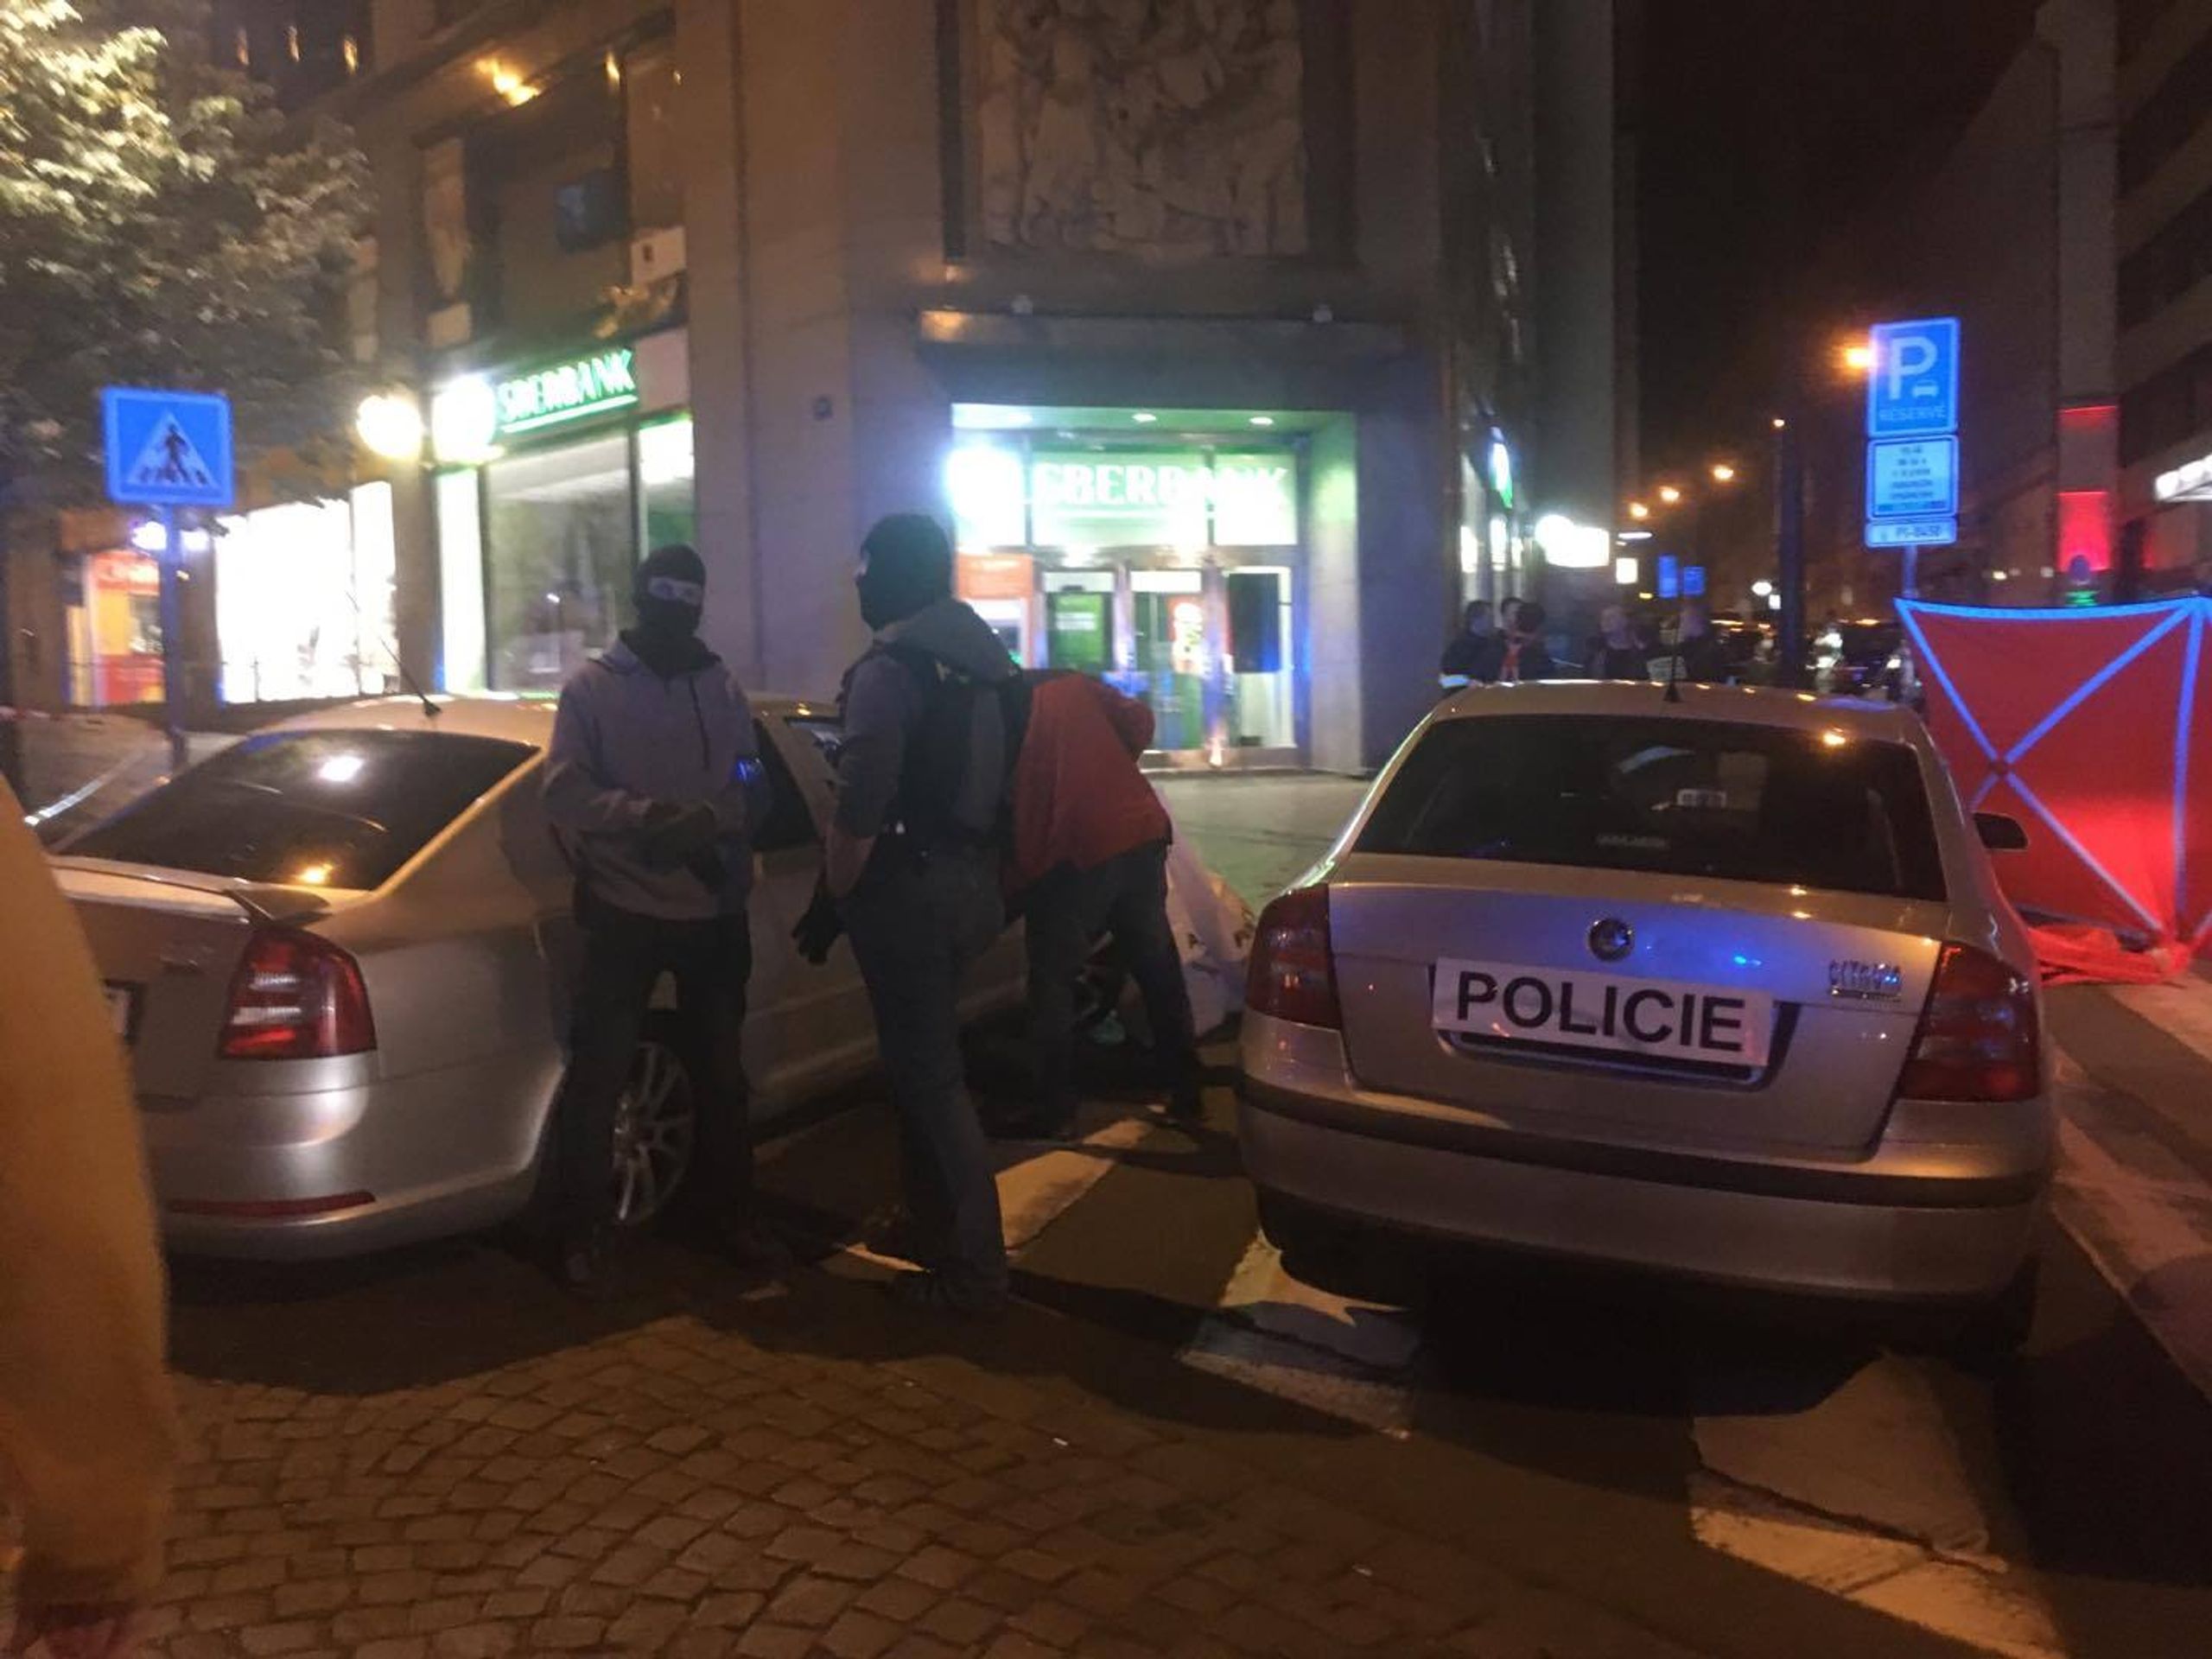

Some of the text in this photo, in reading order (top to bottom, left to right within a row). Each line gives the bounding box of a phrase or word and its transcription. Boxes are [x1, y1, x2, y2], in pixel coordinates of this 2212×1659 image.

[498, 349, 636, 423] SBERBANK
[1889, 335, 1937, 400] P
[1033, 462, 1289, 505] SBERBK
[1457, 970, 1745, 1052] POLICIE
